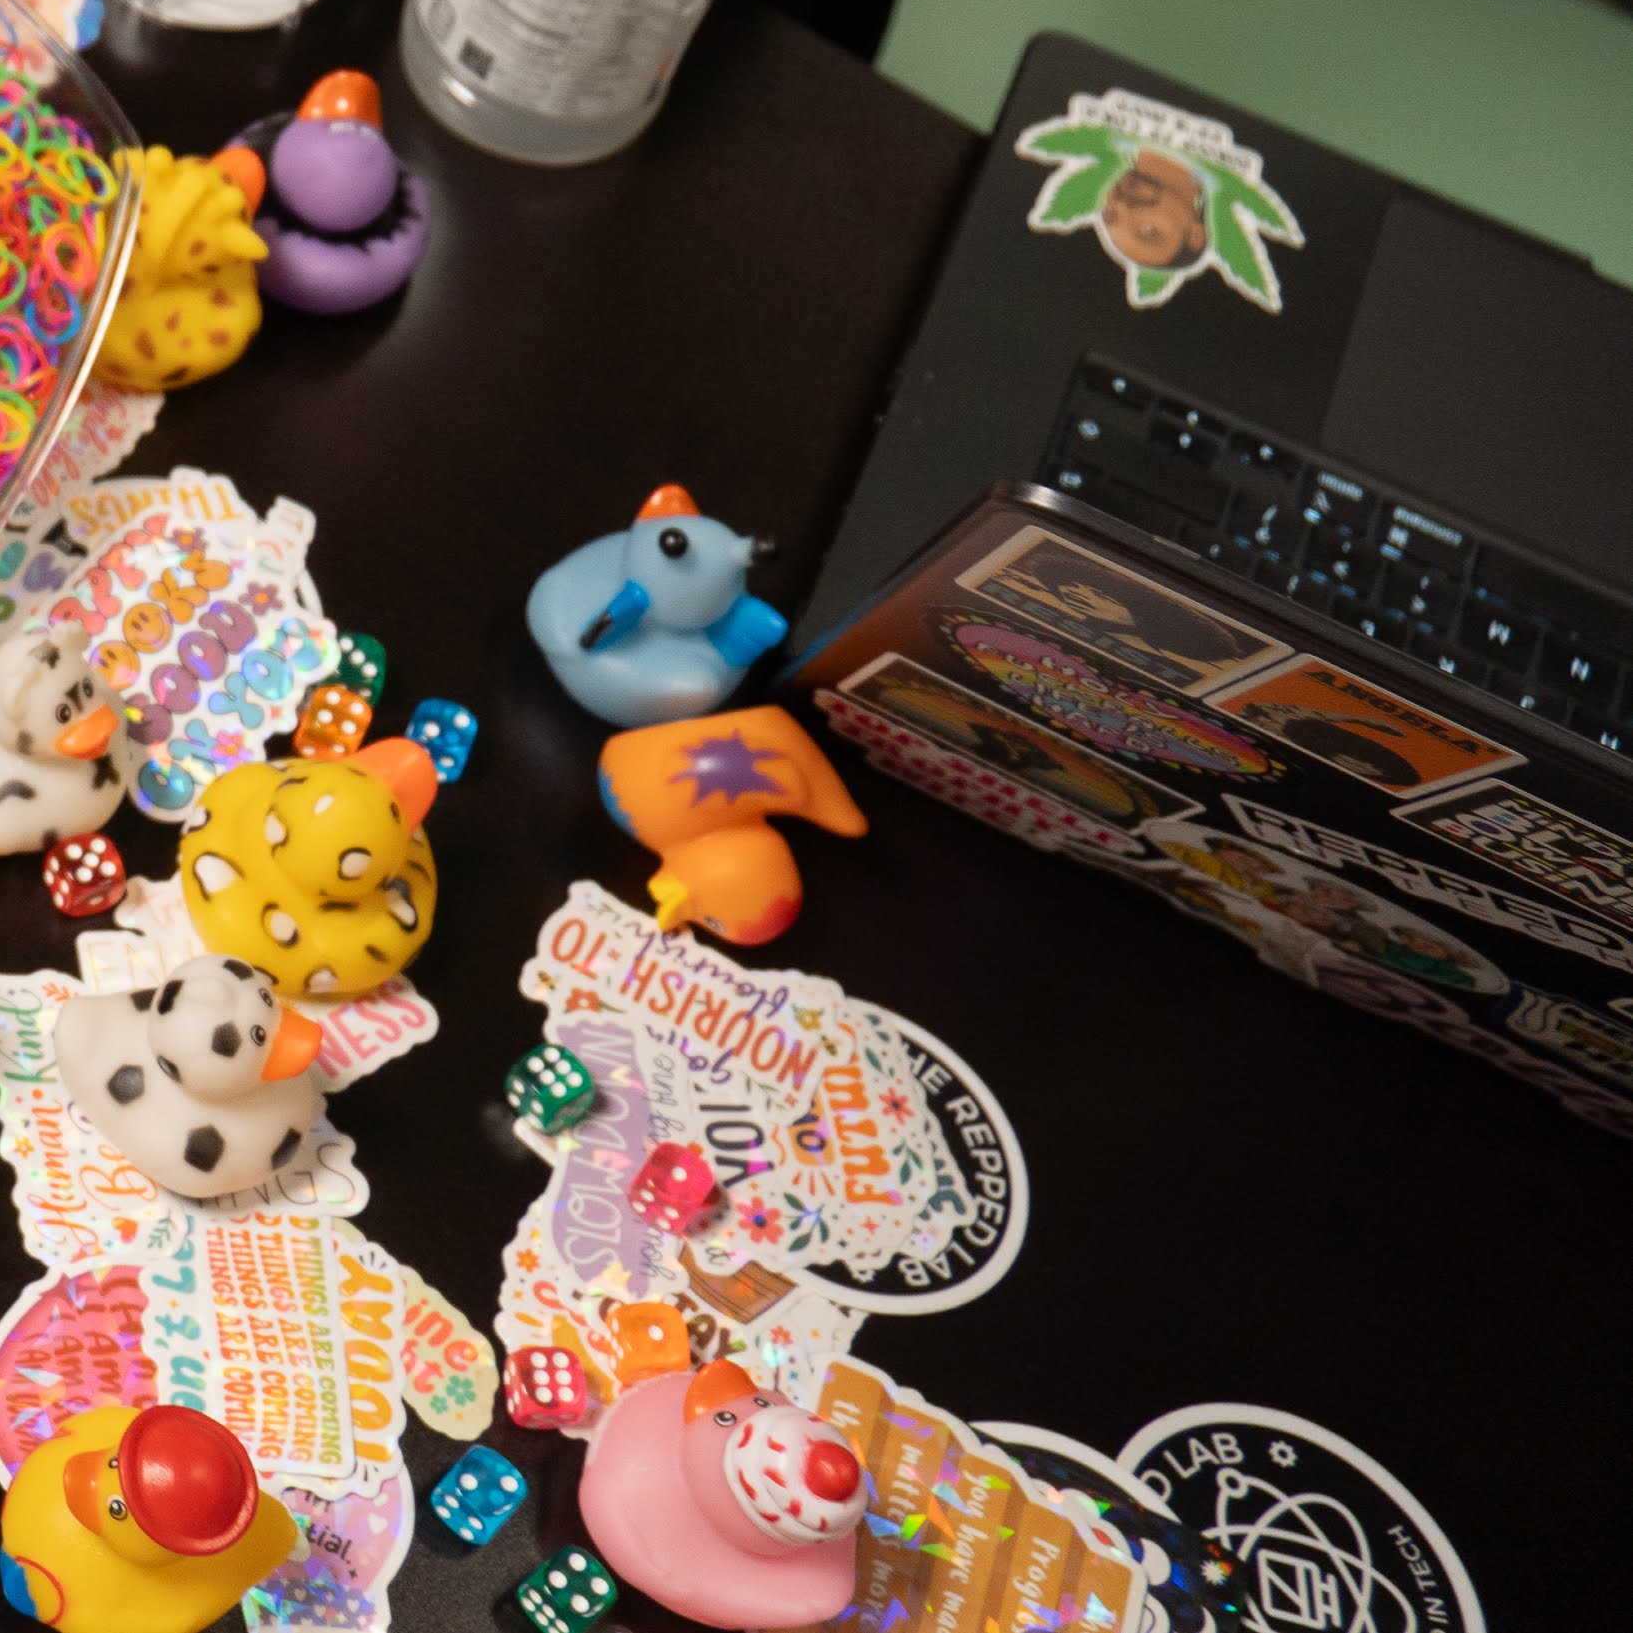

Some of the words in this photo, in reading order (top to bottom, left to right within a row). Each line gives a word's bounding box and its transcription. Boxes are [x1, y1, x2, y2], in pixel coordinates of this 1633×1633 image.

[50, 513, 170, 635] APPY
[978, 581, 1191, 682] RESIST
[1036, 654, 1187, 727] HOLY
[1304, 670, 1481, 754] ANGELA
[1242, 802, 1623, 952] REPPED
[550, 917, 607, 981] TO
[317, 993, 427, 1080] NESS
[622, 961, 819, 1093] NOURISH
[823, 1066, 898, 1207] FUTU
[903, 1046, 952, 1094] HE
[946, 1089, 1007, 1245] REPPED
[560, 1152, 629, 1285] SLOW
[205, 1227, 239, 1307] THINGS
[234, 1232, 268, 1311] THINGS
[270, 1233, 297, 1311] THINGS
[302, 1236, 328, 1315] THINGS
[153, 1309, 206, 1412] on't
[218, 1311, 250, 1363] ARE
[252, 1313, 282, 1366] ARE
[279, 1316, 309, 1367] ARE
[311, 1320, 334, 1372] ARE
[337, 1254, 405, 1464] TODAY
[402, 1298, 479, 1373] ine
[675, 1292, 744, 1367] TAY
[256, 1367, 284, 1460] COMING
[291, 1372, 316, 1464] COMING
[319, 1374, 343, 1466] COMING
[1164, 1431, 1245, 1480] LAB
[1387, 1523, 1439, 1593] TECH
